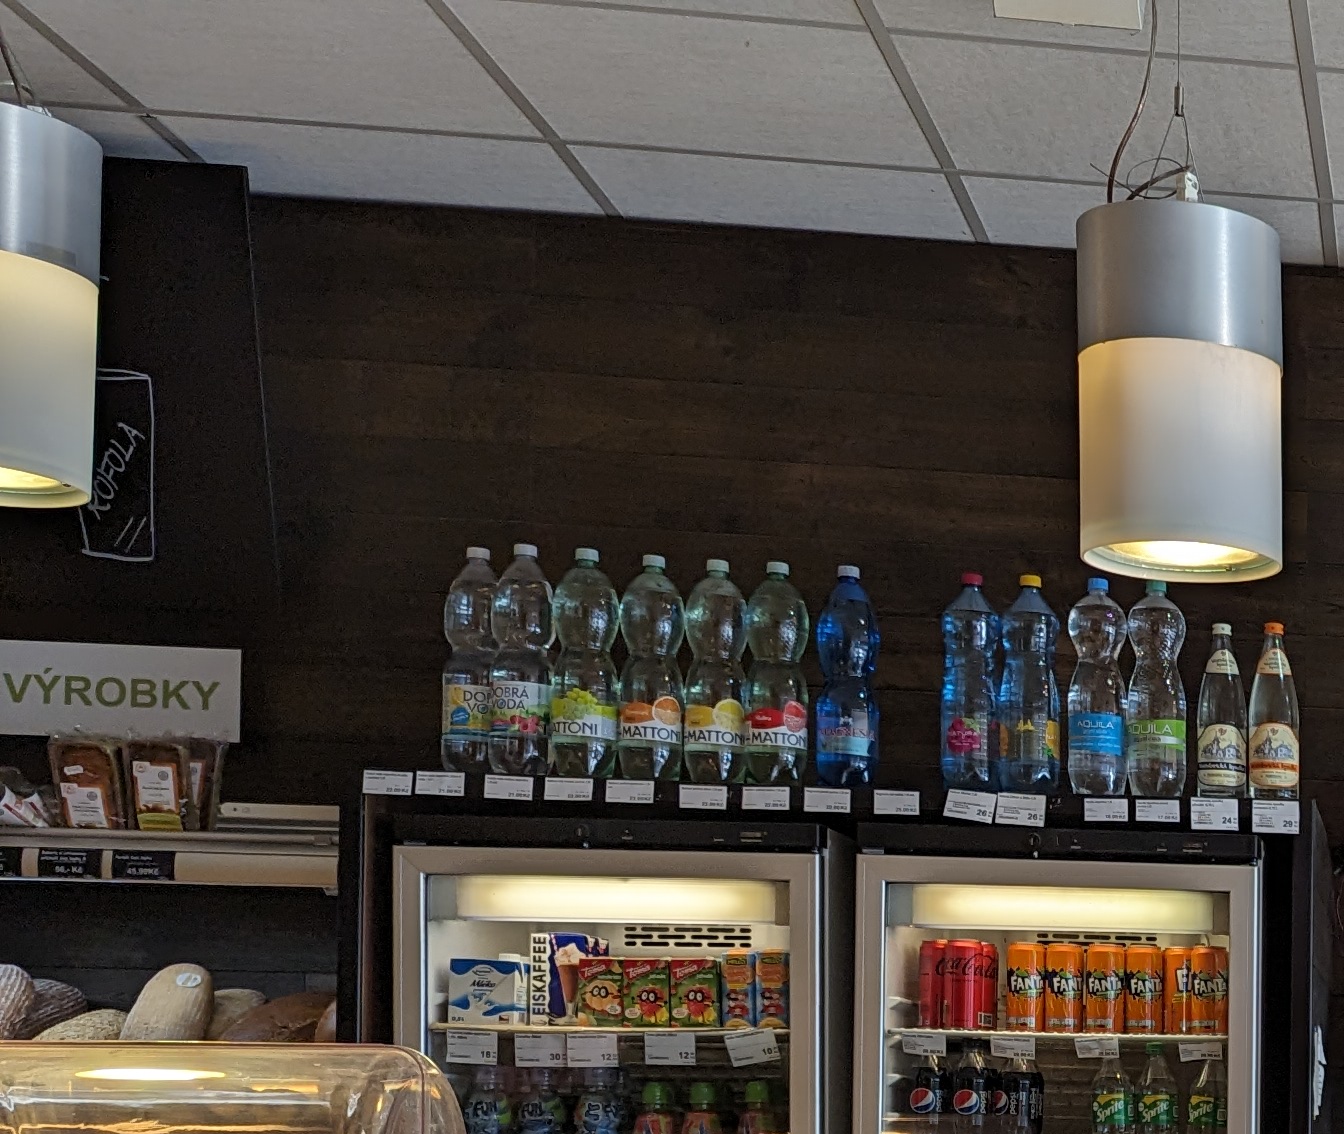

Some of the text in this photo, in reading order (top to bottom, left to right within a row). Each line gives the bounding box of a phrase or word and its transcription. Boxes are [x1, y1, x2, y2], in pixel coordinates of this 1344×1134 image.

[88, 423, 146, 520] KOFOLA
[3, 667, 220, 710] VÝROBKY
[532, 936, 547, 1018] EISKAFFEE
[1096, 1099, 1125, 1122] Sprite
